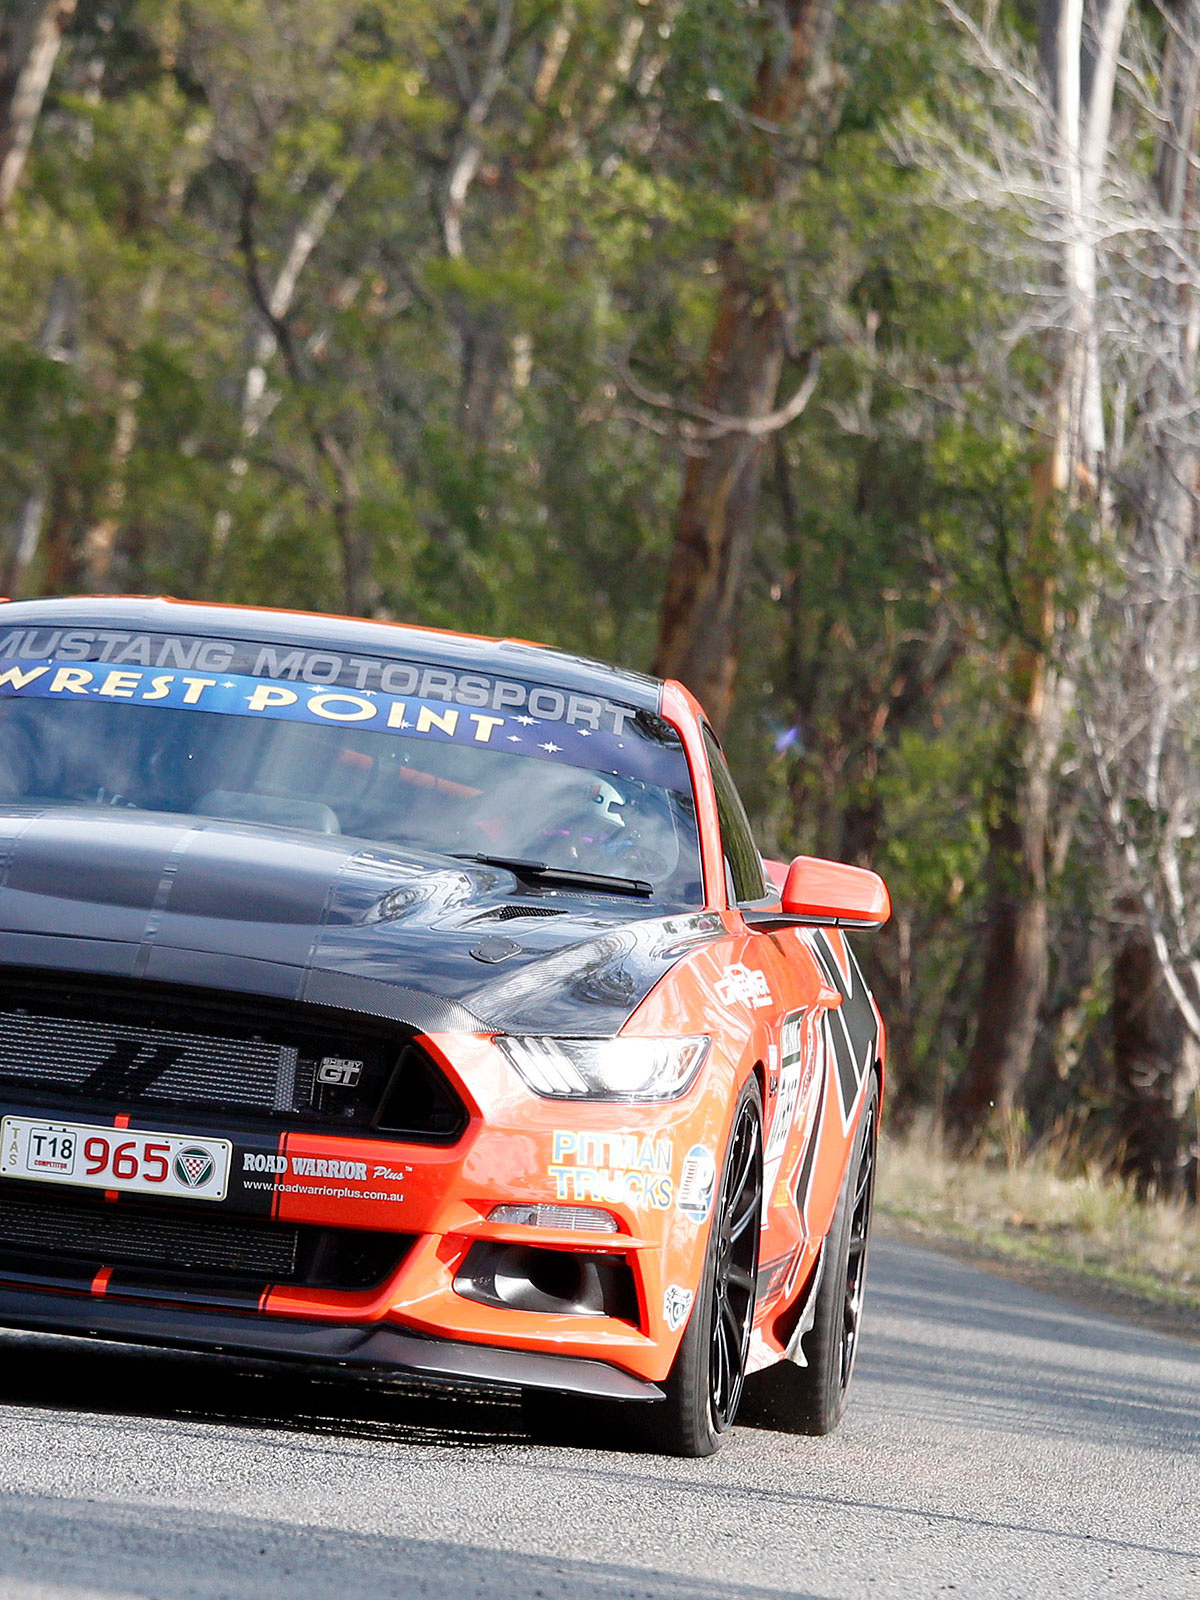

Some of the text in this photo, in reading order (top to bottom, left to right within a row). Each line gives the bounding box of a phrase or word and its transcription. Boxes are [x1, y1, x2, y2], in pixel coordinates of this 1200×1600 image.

[251, 647, 637, 736] MOTORSPORT
[247, 684, 505, 743] POINT
[319, 1064, 361, 1085] GT
[8, 1127, 22, 1166] TAS
[33, 1134, 73, 1160] T18
[83, 1137, 172, 1183] 965
[242, 1153, 288, 1174] ROAD
[291, 1157, 368, 1181] WARRIOR
[552, 1129, 674, 1175] PITMAN
[242, 1179, 405, 1203] www.roadwarriorplus.com.au
[547, 1165, 675, 1211] TRUCKS
